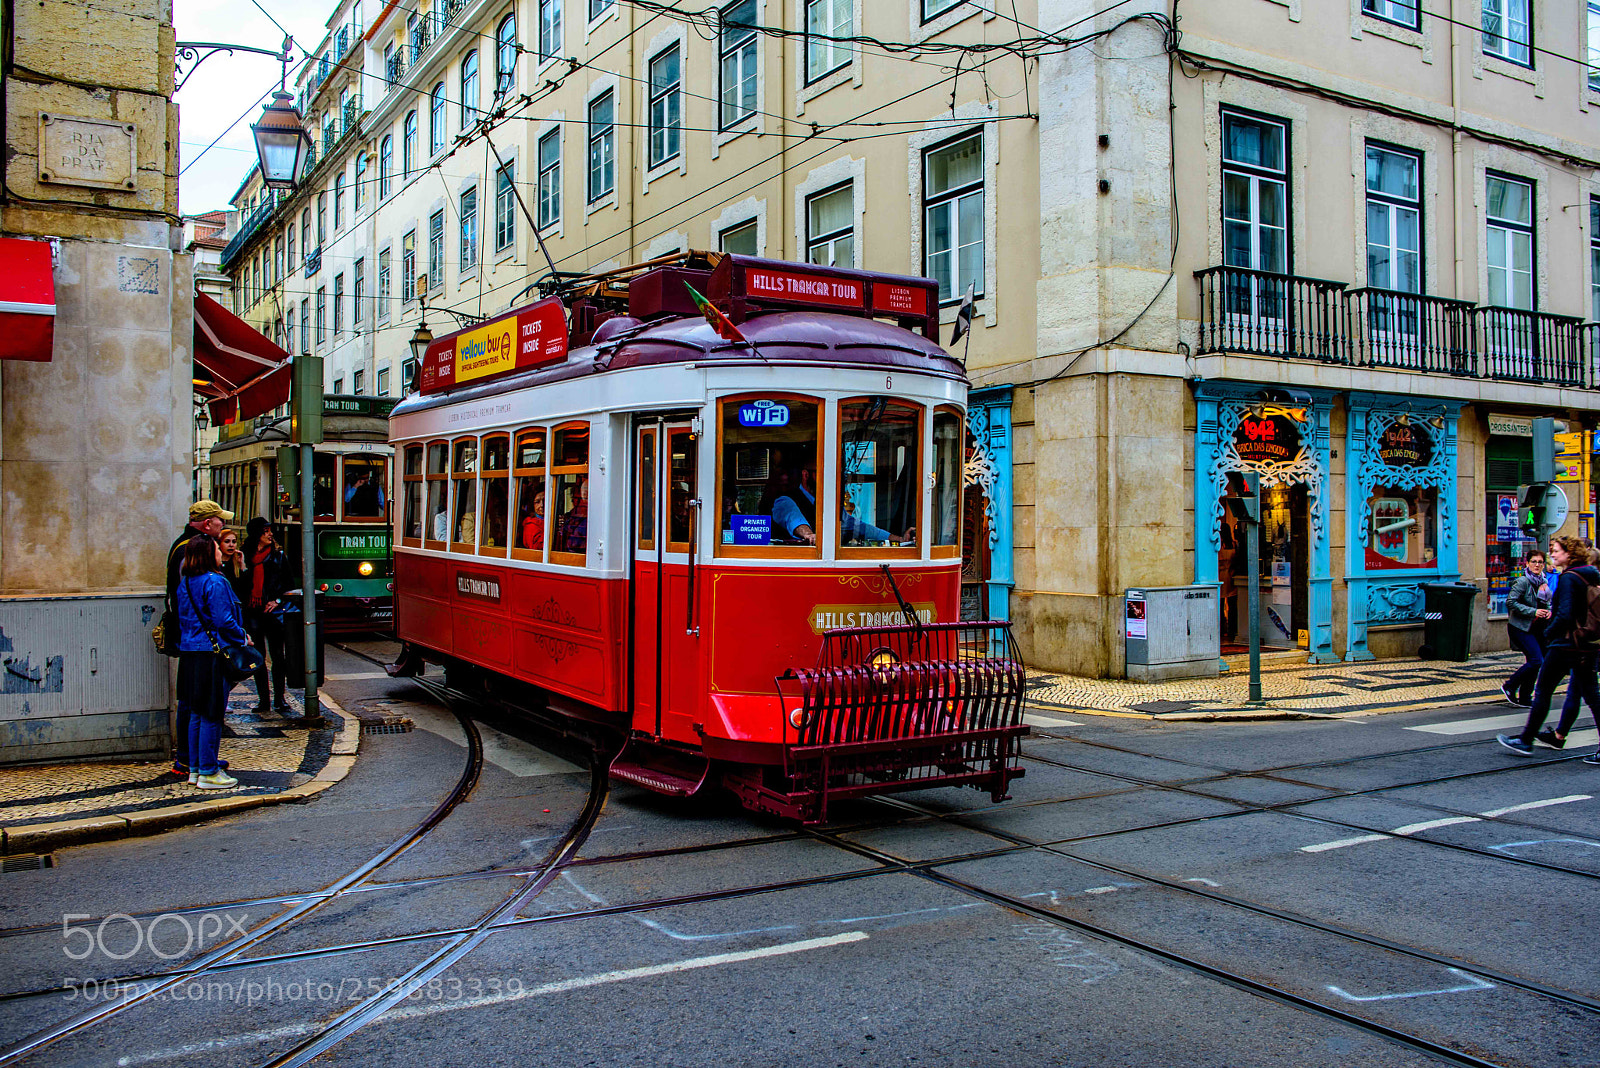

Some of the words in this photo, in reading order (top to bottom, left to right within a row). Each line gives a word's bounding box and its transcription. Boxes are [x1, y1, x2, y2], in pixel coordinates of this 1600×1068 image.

[79, 145, 99, 158] DA
[61, 155, 115, 171] PRATA
[753, 274, 784, 292] HILLS
[786, 278, 830, 297] TRAMCAR
[831, 283, 857, 300] TOUR
[891, 287, 910, 295] LISBON
[522, 320, 542, 337] TICKETS
[460, 339, 487, 361] yellow
[487, 334, 501, 354] bus
[522, 338, 539, 354] INSIDE
[438, 349, 453, 363] TICKETS
[438, 364, 451, 377] INSIDE
[886, 376, 892, 390] 6
[323, 400, 339, 409] RAM
[341, 401, 360, 410] TOUR
[1244, 419, 1275, 441] 1942
[1386, 428, 1412, 447] 1942
[1253, 442, 1265, 452] DAS
[339, 535, 366, 548] TRAM
[368, 535, 392, 548] TOU
[816, 612, 856, 629] HILLS
[915, 609, 932, 624] OUR
